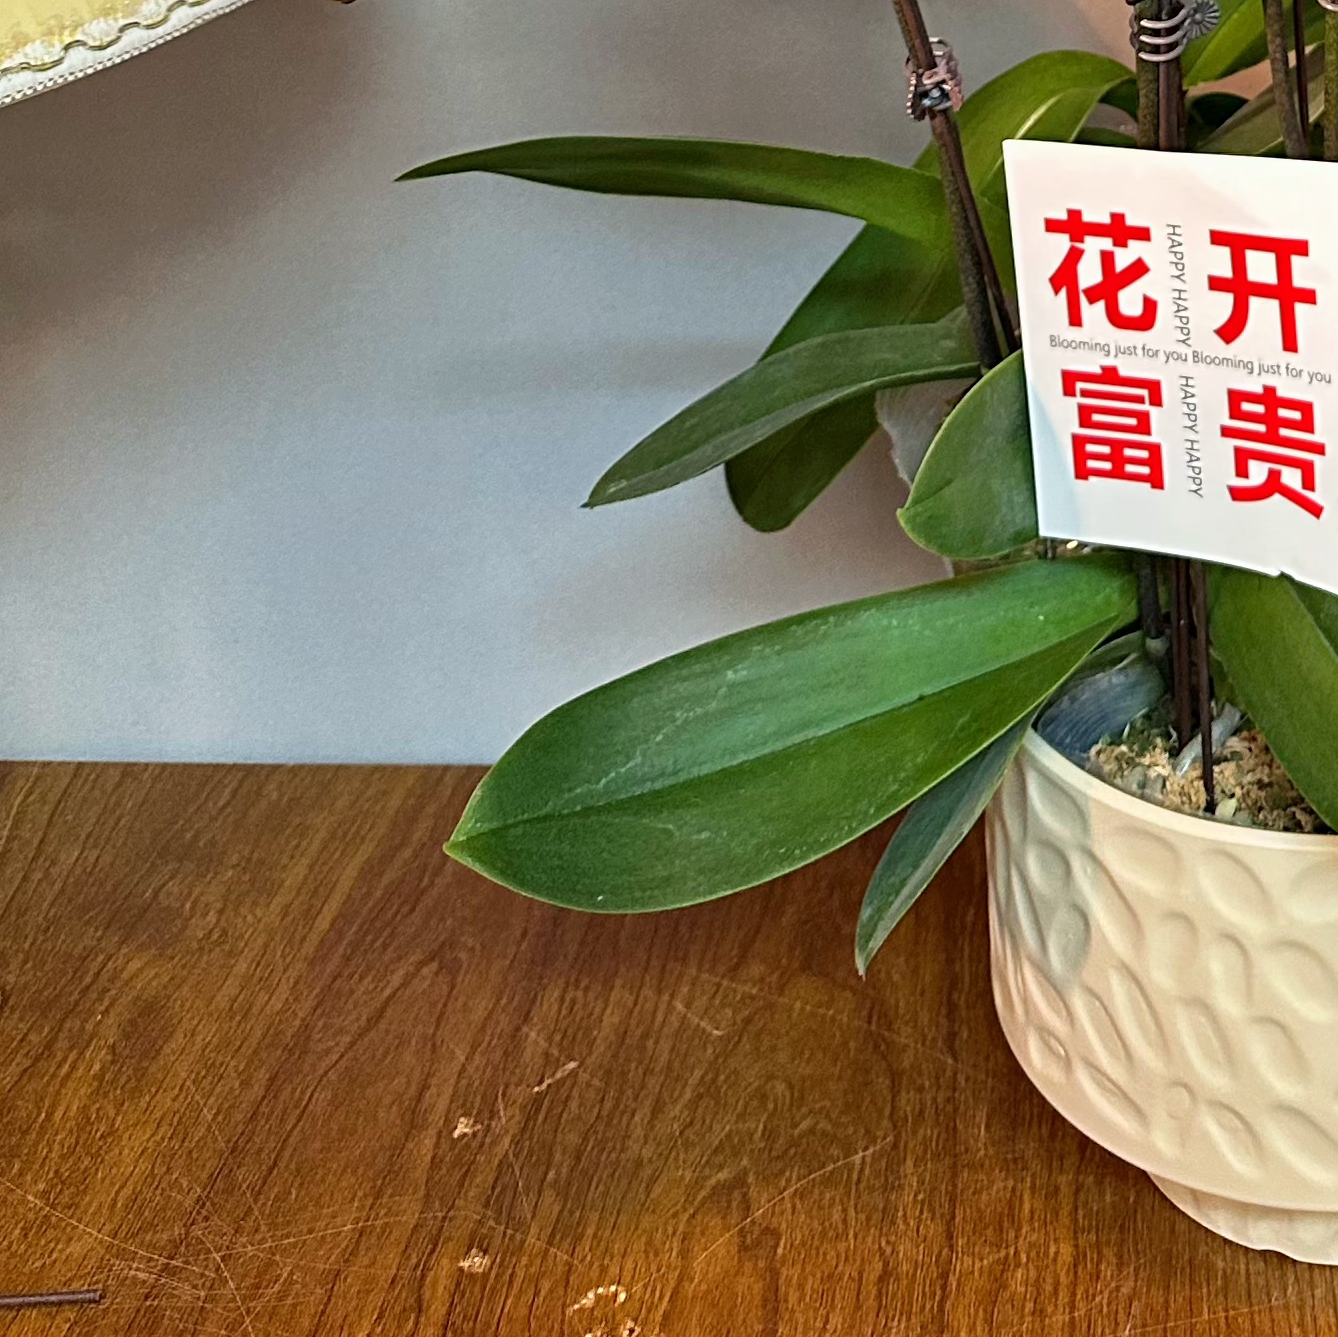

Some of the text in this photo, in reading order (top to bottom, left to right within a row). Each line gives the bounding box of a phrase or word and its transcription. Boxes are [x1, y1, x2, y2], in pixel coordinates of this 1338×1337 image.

[1044, 208, 1317, 354] 花开
[1166, 224, 1192, 348] HAPPY HAPPY
[1049, 335, 1332, 384] Blooming just for you Blooming just for you
[1061, 365, 1326, 520] 富贵
[1179, 375, 1204, 498] HAPPY HAPPY
